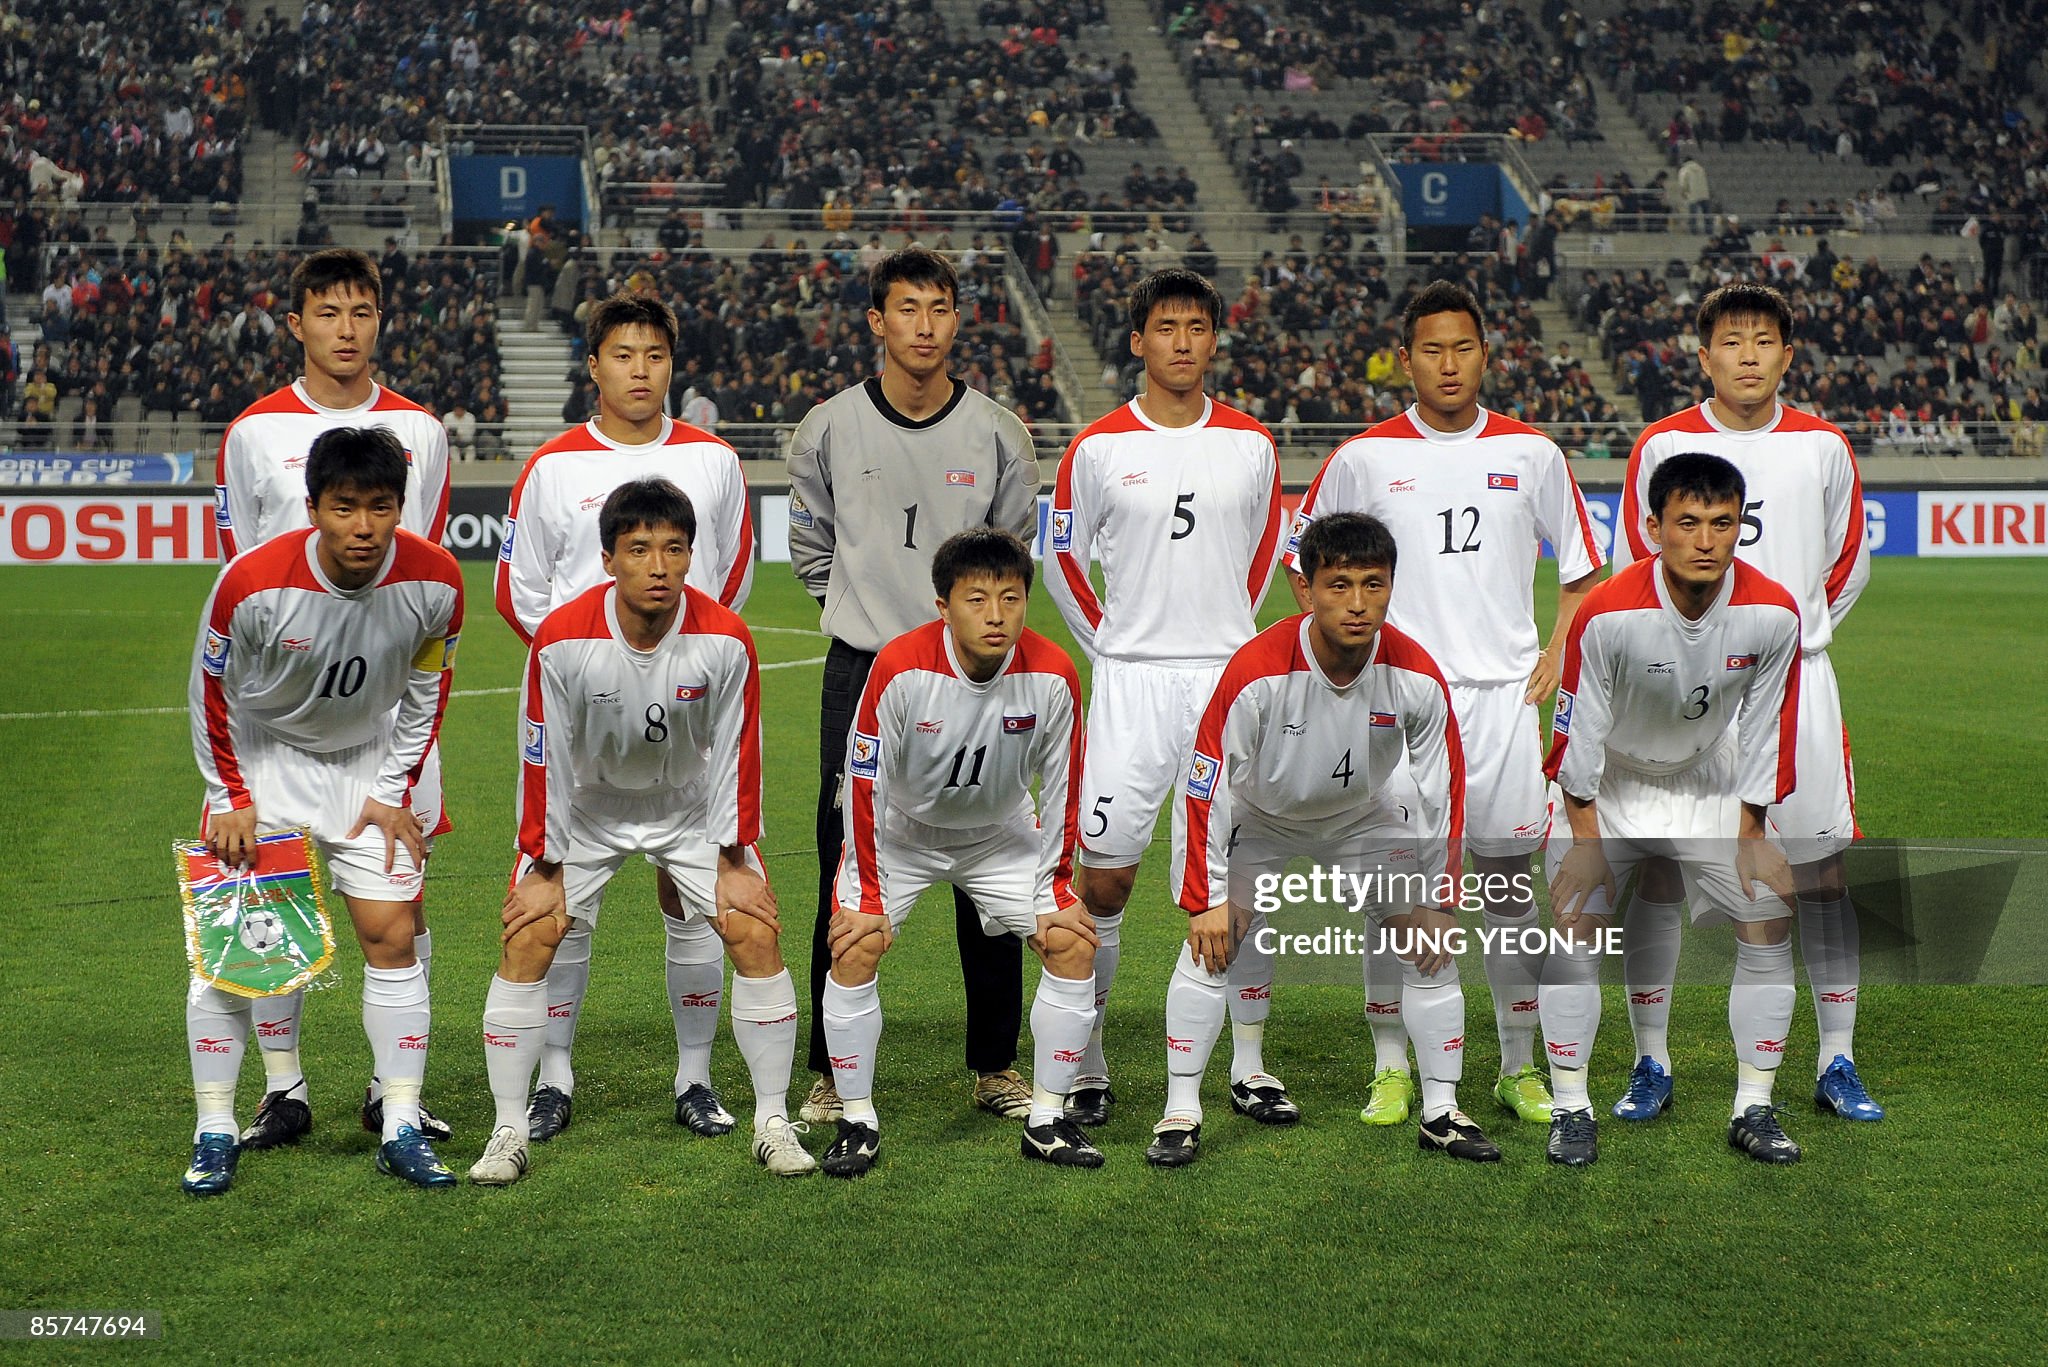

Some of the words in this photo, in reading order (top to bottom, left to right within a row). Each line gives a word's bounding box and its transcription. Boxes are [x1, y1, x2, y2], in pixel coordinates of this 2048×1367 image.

[501, 166, 526, 198] D
[1422, 172, 1448, 204] C
[1122, 478, 1148, 487] ERKE
[1389, 485, 1415, 493] ERKE
[1170, 492, 1196, 540] 5
[0, 503, 218, 560] OSHI
[903, 503, 918, 550] 1
[1437, 506, 1482, 555] 12
[318, 655, 367, 699] 10
[1683, 684, 1710, 720] 3
[644, 702, 668, 743] 8
[916, 727, 943, 735] ERKE
[1283, 728, 1308, 736] ERKE
[943, 744, 987, 788] 11
[1331, 748, 1354, 788] 4
[1085, 795, 1114, 838] 5
[1514, 829, 1539, 838] ERKE
[1389, 853, 1415, 861] ERKE
[389, 878, 414, 886] ERKE
[1241, 991, 1270, 1000] ERKE
[1822, 996, 1857, 1004] ERKE
[1630, 997, 1664, 1005] ERKE
[1366, 1006, 1399, 1014] ERKE
[258, 1026, 291, 1037] ERKE
[196, 1044, 230, 1053] ERKE
[1168, 1043, 1192, 1053] RKE
